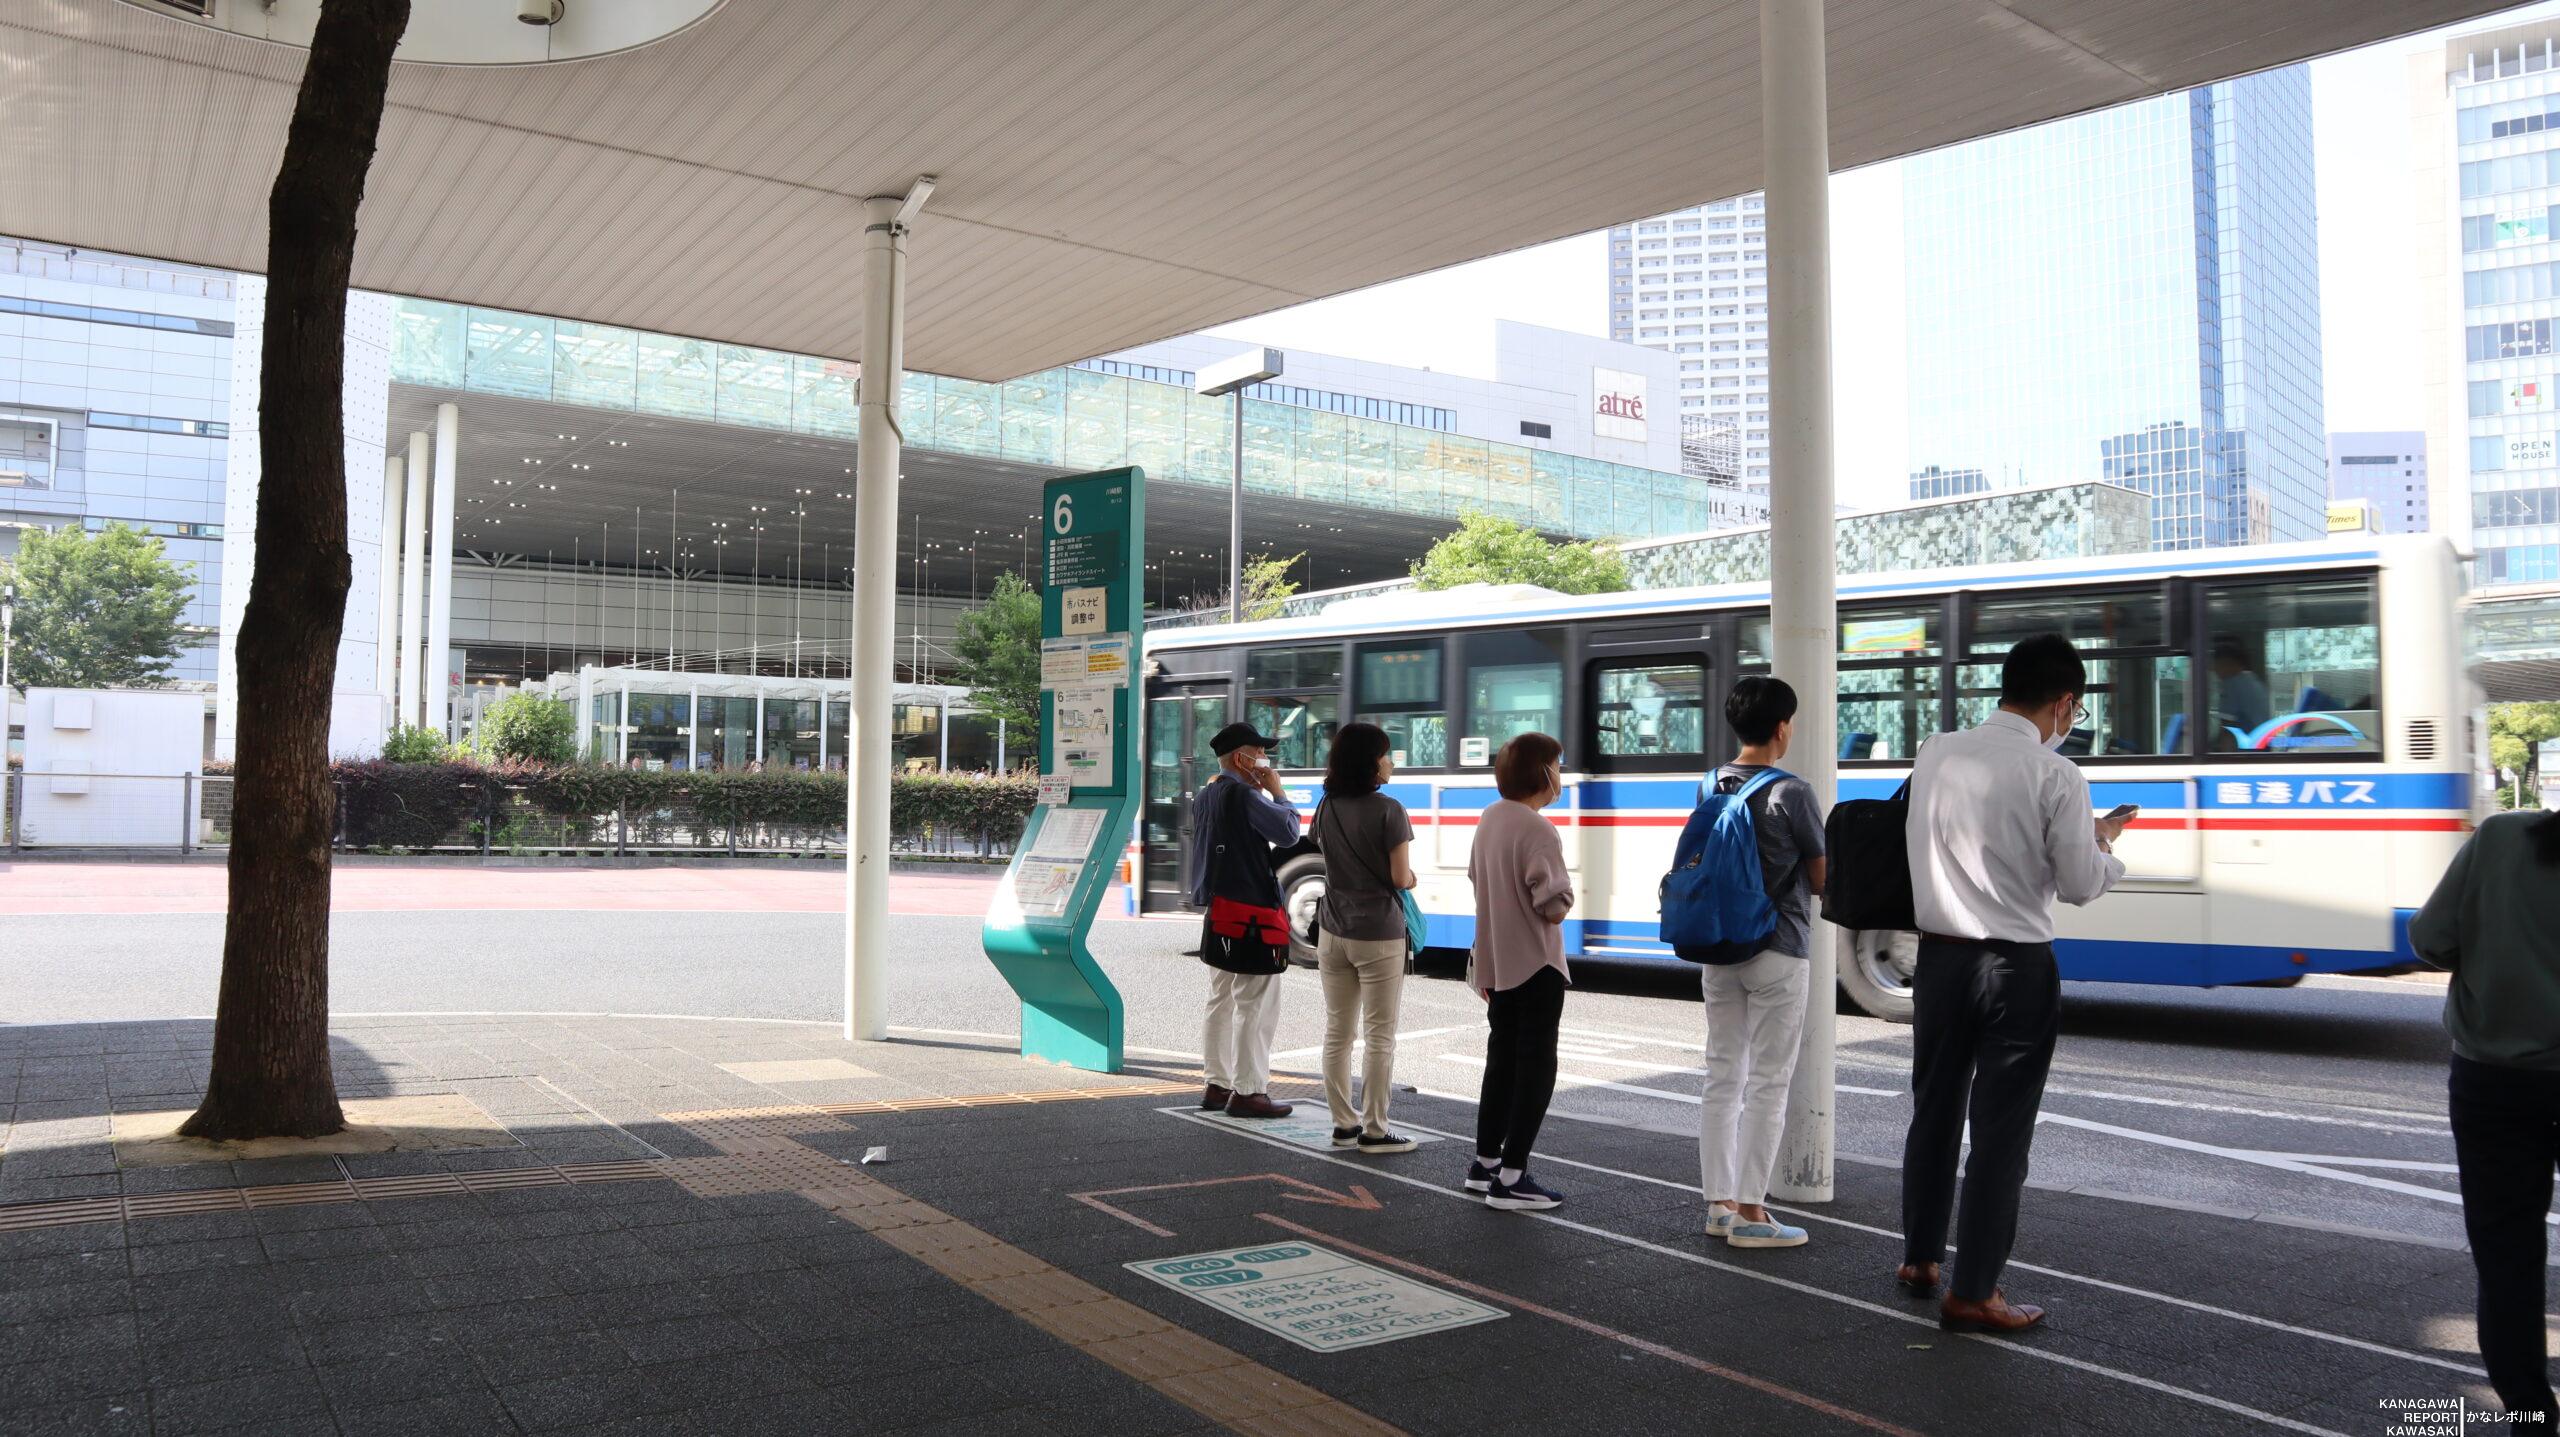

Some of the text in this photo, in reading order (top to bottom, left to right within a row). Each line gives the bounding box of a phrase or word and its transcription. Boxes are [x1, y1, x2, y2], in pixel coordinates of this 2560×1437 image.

[1599, 391, 1642, 418] atré
[2511, 441, 2550, 451] OPEN
[2512, 451, 2550, 460] HOUSE
[1054, 494, 1072, 534] 6
[2327, 515, 2356, 524] Times
[1066, 596, 1099, 609] 市バスナビ
[1071, 613, 1095, 624] 調整中
[1058, 691, 1064, 702] 6
[2217, 781, 2377, 804] 臨港バス
[1163, 1259, 1226, 1272] 川40
[1190, 1270, 1248, 1285] 川17
[1240, 1278, 1391, 1309] お待ちください
[1264, 1292, 1396, 1320] 矢印のとおり
[1288, 1306, 1405, 1331] 折り返して
[1316, 1307, 1474, 1341] お並びください
